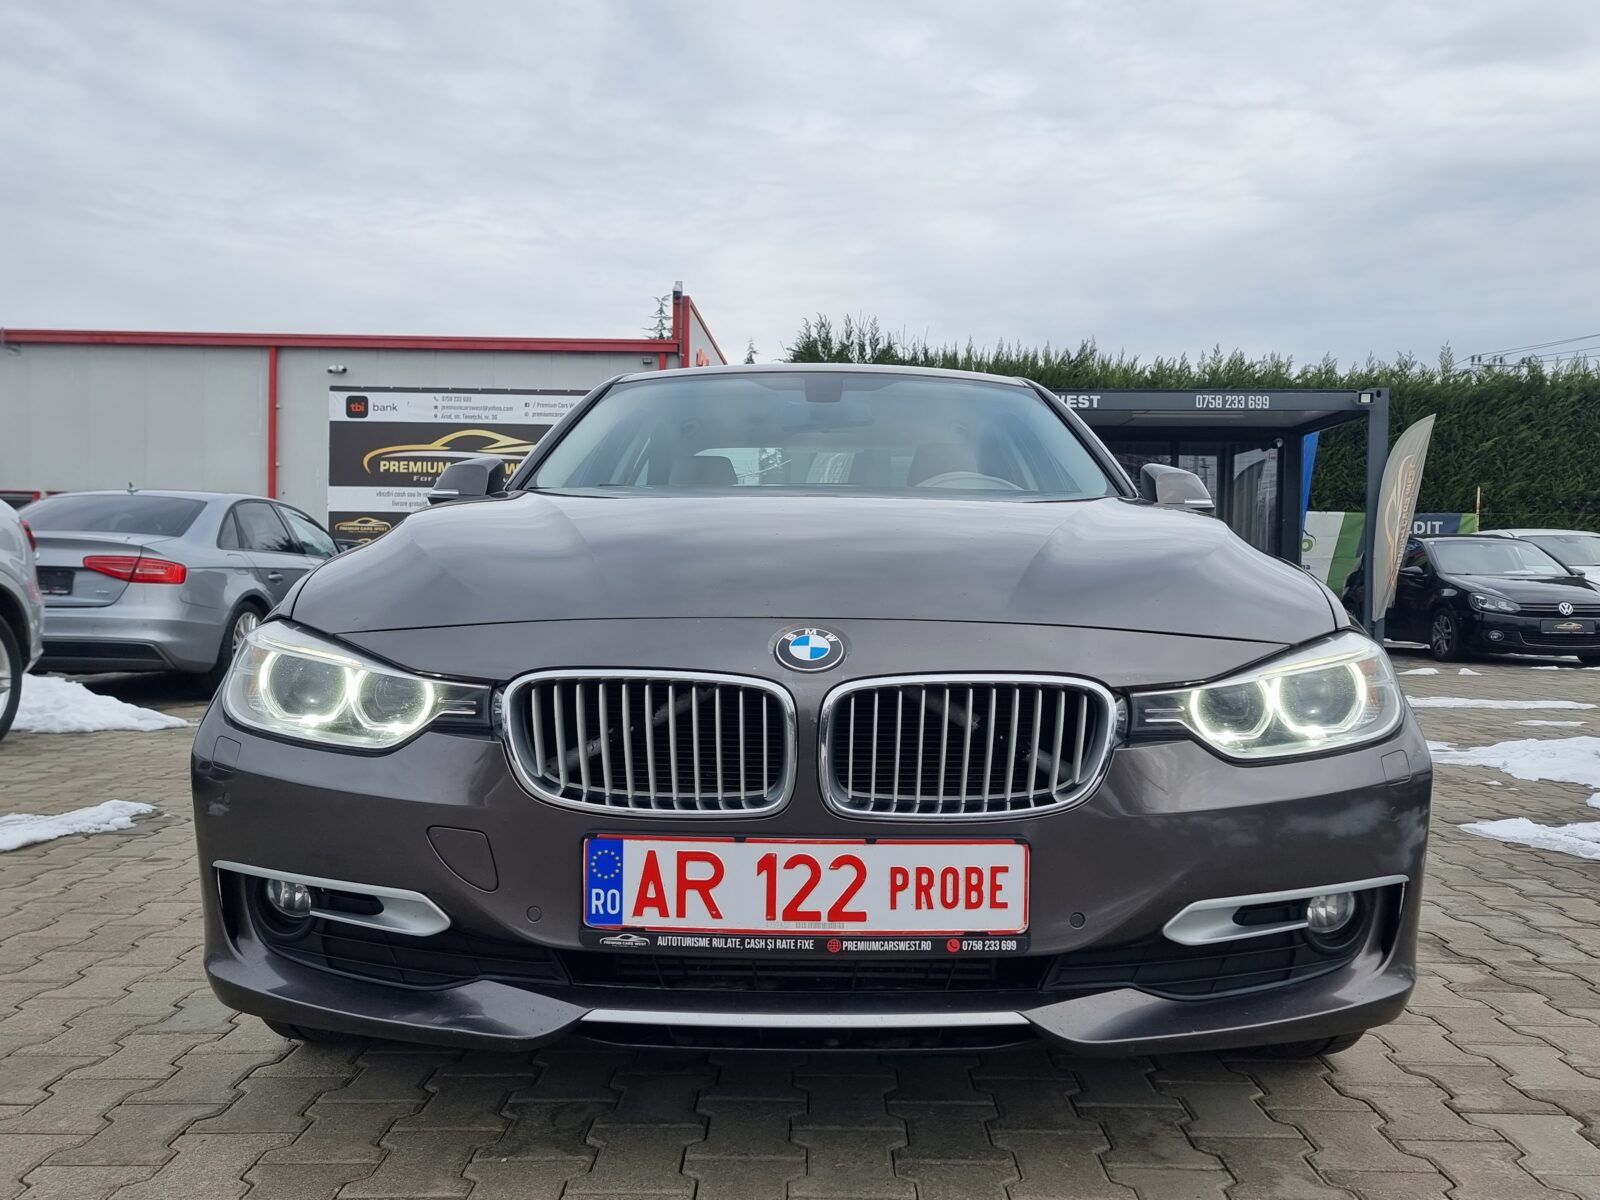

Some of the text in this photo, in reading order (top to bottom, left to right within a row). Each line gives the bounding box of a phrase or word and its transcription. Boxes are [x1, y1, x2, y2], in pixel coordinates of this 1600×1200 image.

[350, 402, 365, 412] tbi
[372, 402, 399, 412] bank
[1196, 395, 1270, 409] 0758 233 699
[379, 460, 451, 473] PREMIUM
[1409, 521, 1443, 534] DIT
[784, 628, 838, 641] BMW
[632, 850, 1010, 922] AR 122 PROBE
[591, 888, 620, 915] RO
[657, 936, 711, 948] AUTOTURISME
[712, 937, 743, 949] RULATE,
[744, 938, 766, 949] CASH
[777, 939, 796, 950] RATE
[797, 939, 815, 950] FIXE
[842, 940, 932, 951] PREMIUMCARSWEST.RO
[962, 940, 1017, 951] 0758 233 699
